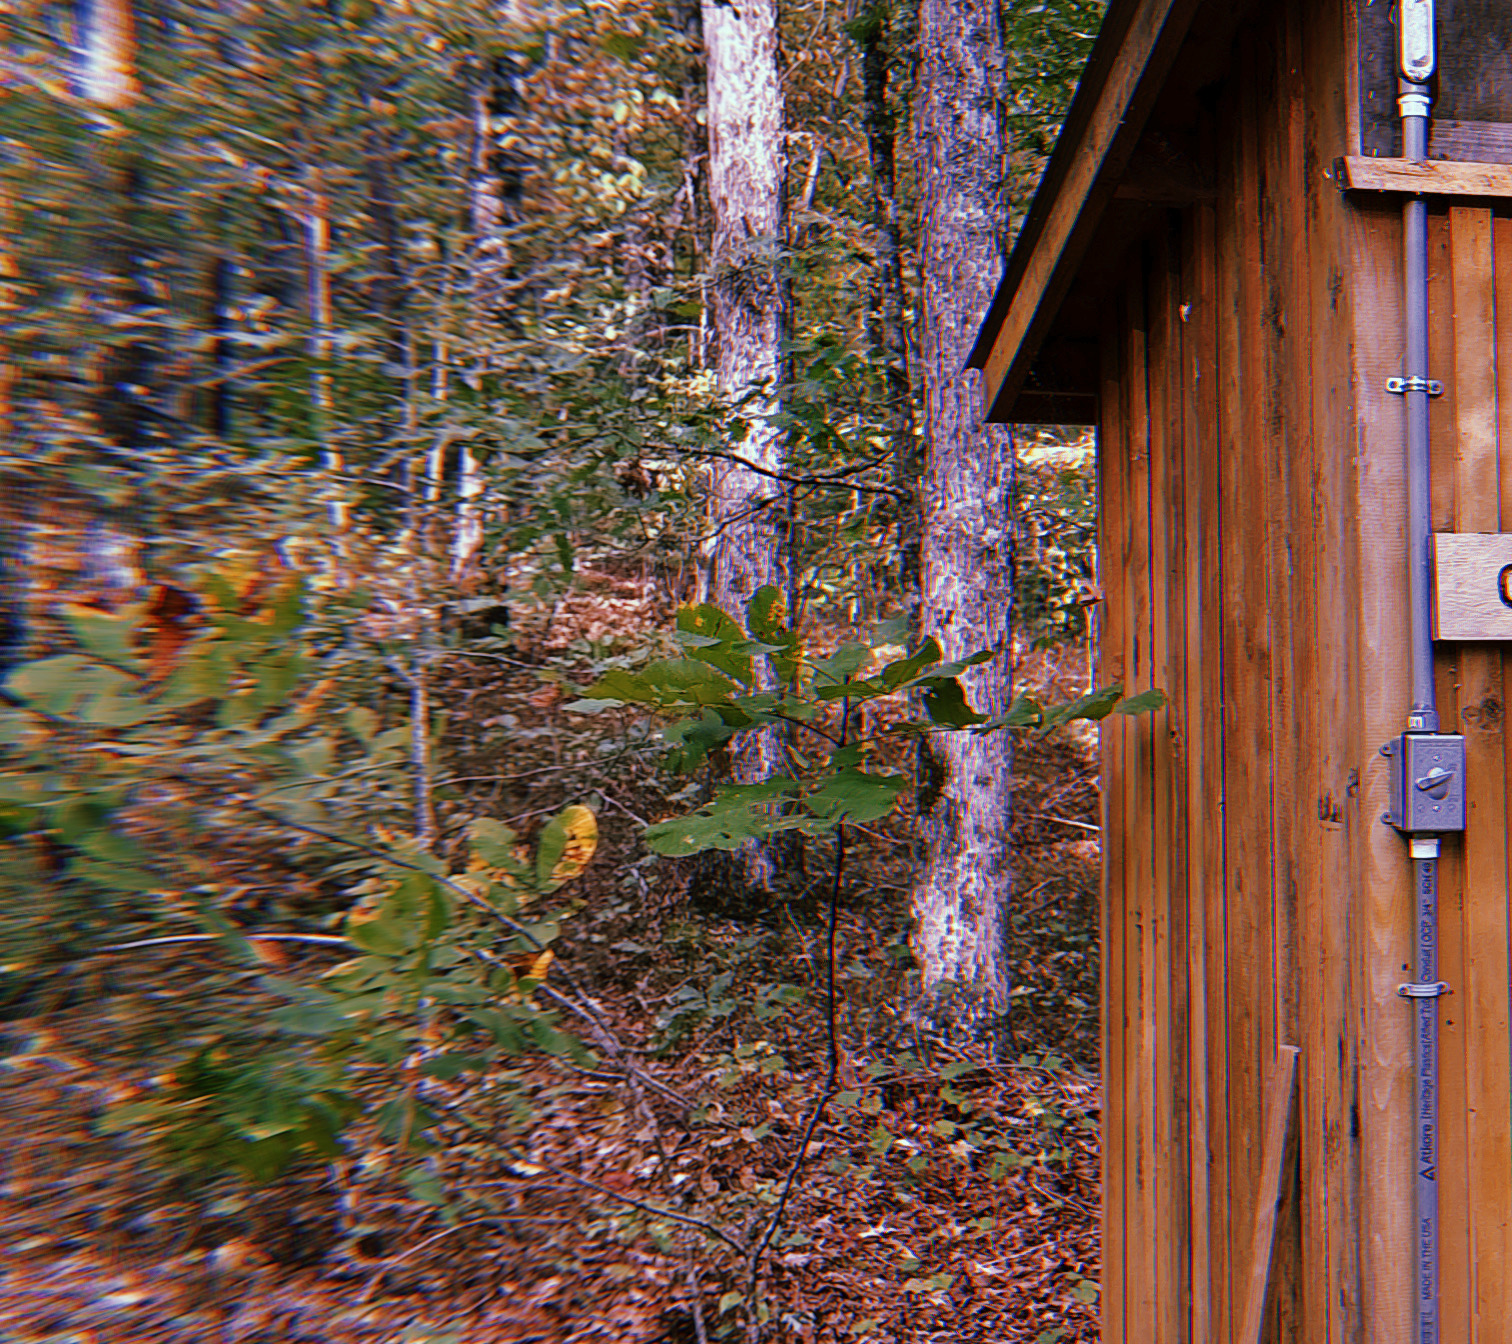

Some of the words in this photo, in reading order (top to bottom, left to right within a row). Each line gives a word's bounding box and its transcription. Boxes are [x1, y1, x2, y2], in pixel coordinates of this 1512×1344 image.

[1421, 1123, 1433, 1164] Atkore
[1422, 1216, 1433, 1237] USA
[1422, 1238, 1433, 1258] THE
[1422, 1272, 1433, 1300] MADE
